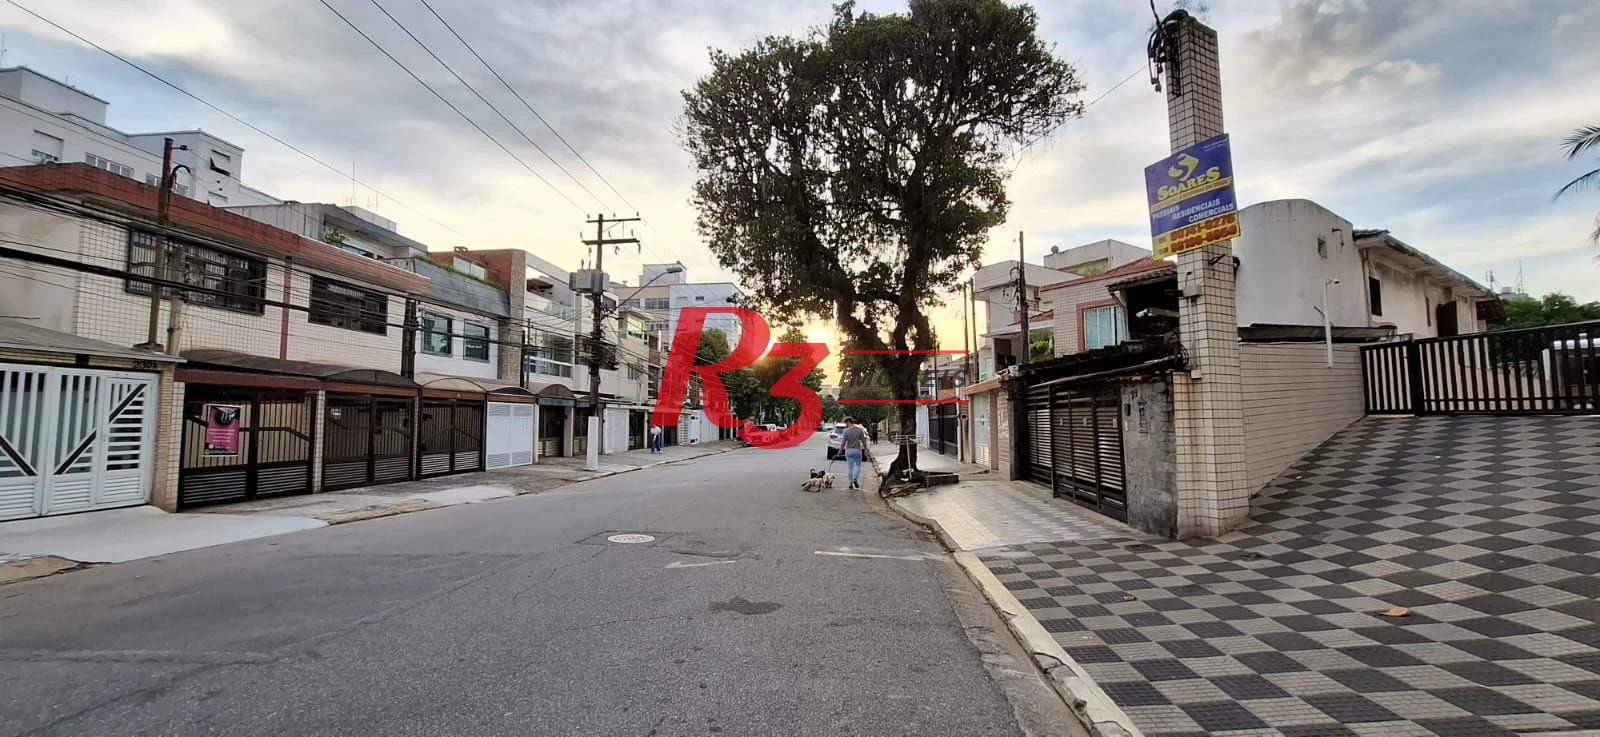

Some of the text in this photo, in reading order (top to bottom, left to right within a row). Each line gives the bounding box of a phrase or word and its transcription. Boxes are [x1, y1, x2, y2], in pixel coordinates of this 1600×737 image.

[1158, 166, 1221, 200] SOARES
[1172, 198, 1221, 220] RESIDENCIAIS
[1188, 203, 1234, 223] COMERCIAIS
